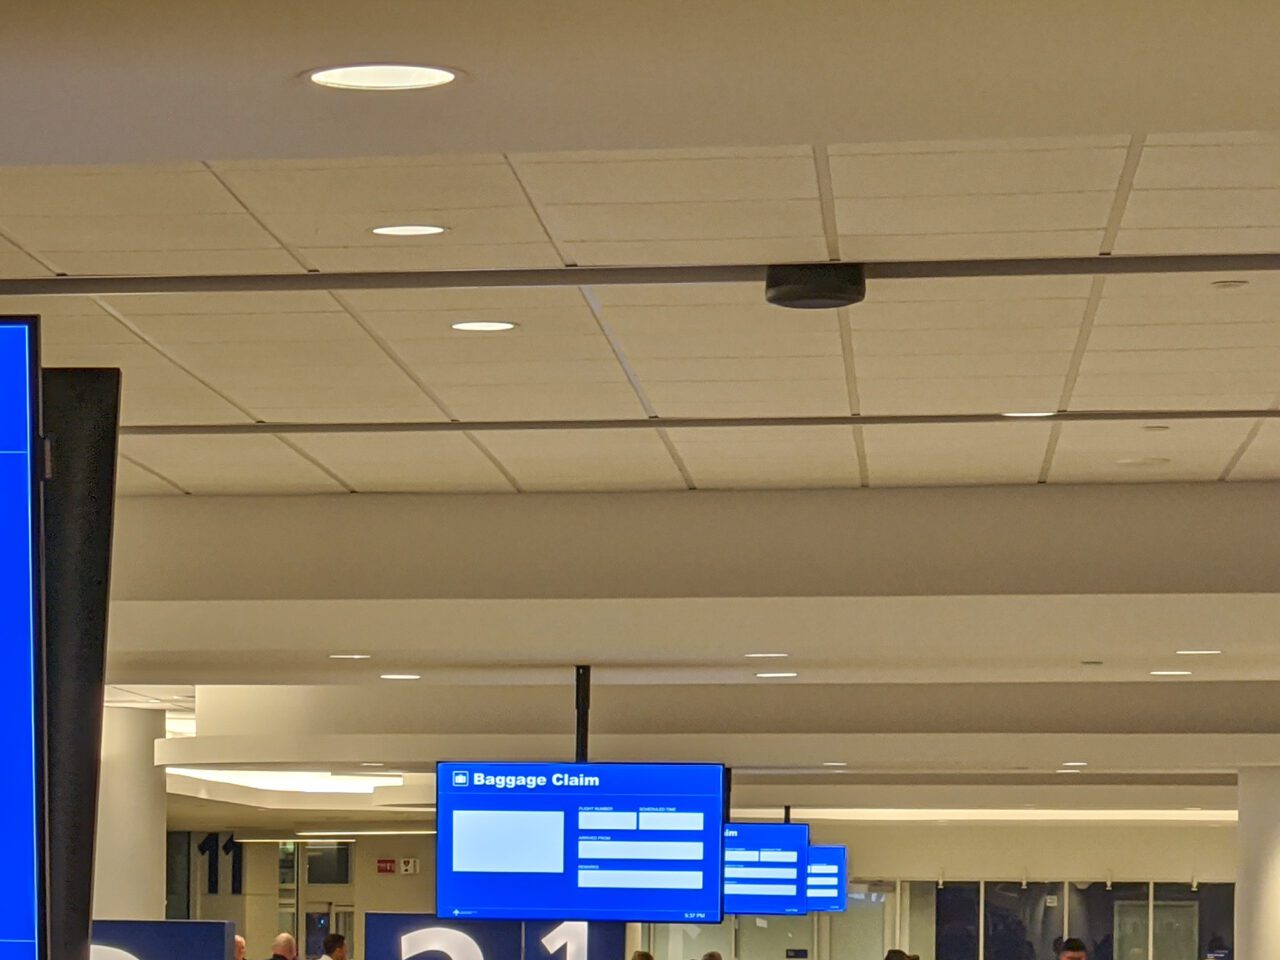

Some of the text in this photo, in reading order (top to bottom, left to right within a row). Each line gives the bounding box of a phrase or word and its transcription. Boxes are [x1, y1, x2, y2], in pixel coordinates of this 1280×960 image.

[473, 772, 600, 789] Baggage Claim
[197, 833, 243, 894] 11
